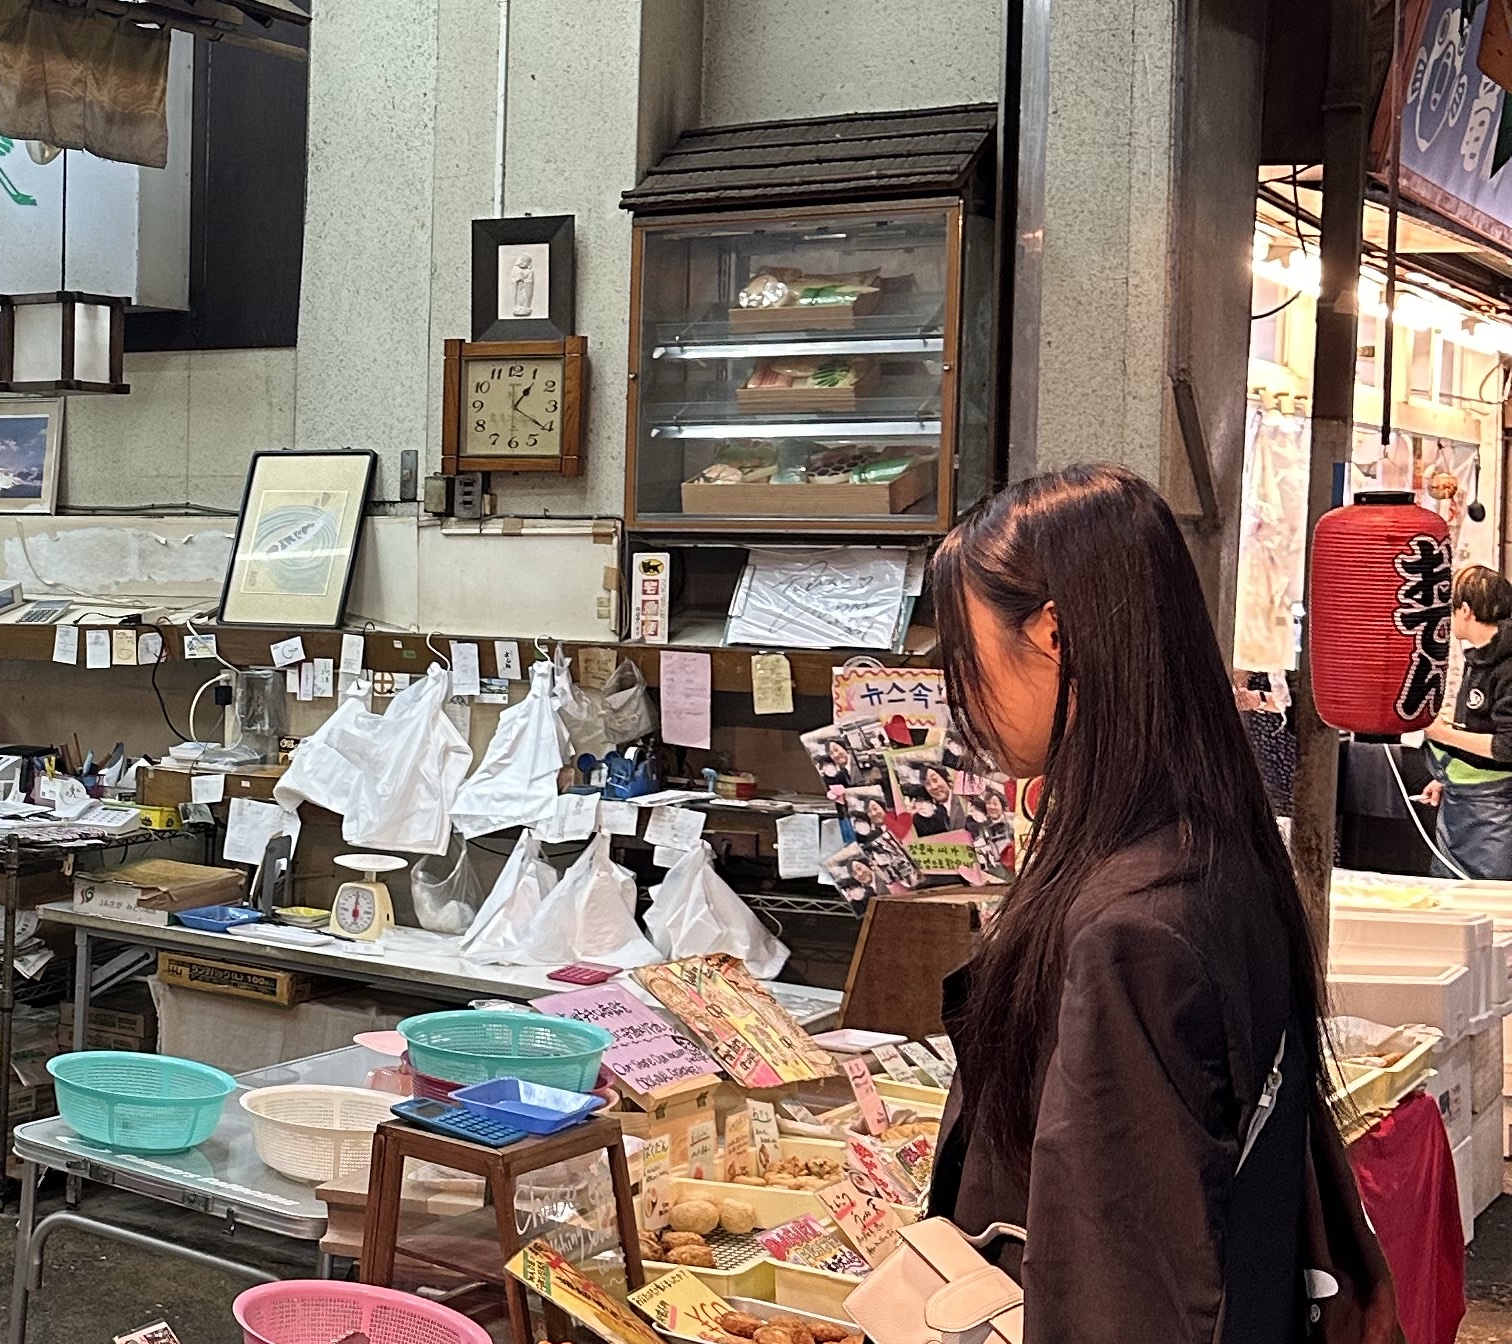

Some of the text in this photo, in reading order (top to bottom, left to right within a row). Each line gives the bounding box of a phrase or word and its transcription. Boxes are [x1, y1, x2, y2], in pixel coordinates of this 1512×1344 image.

[491, 365, 538, 380] 11 12 1
[475, 380, 556, 394] 10 2
[472, 399, 558, 413] 9 3
[474, 419, 554, 432] 8 4
[489, 433, 540, 449] 7 6 5
